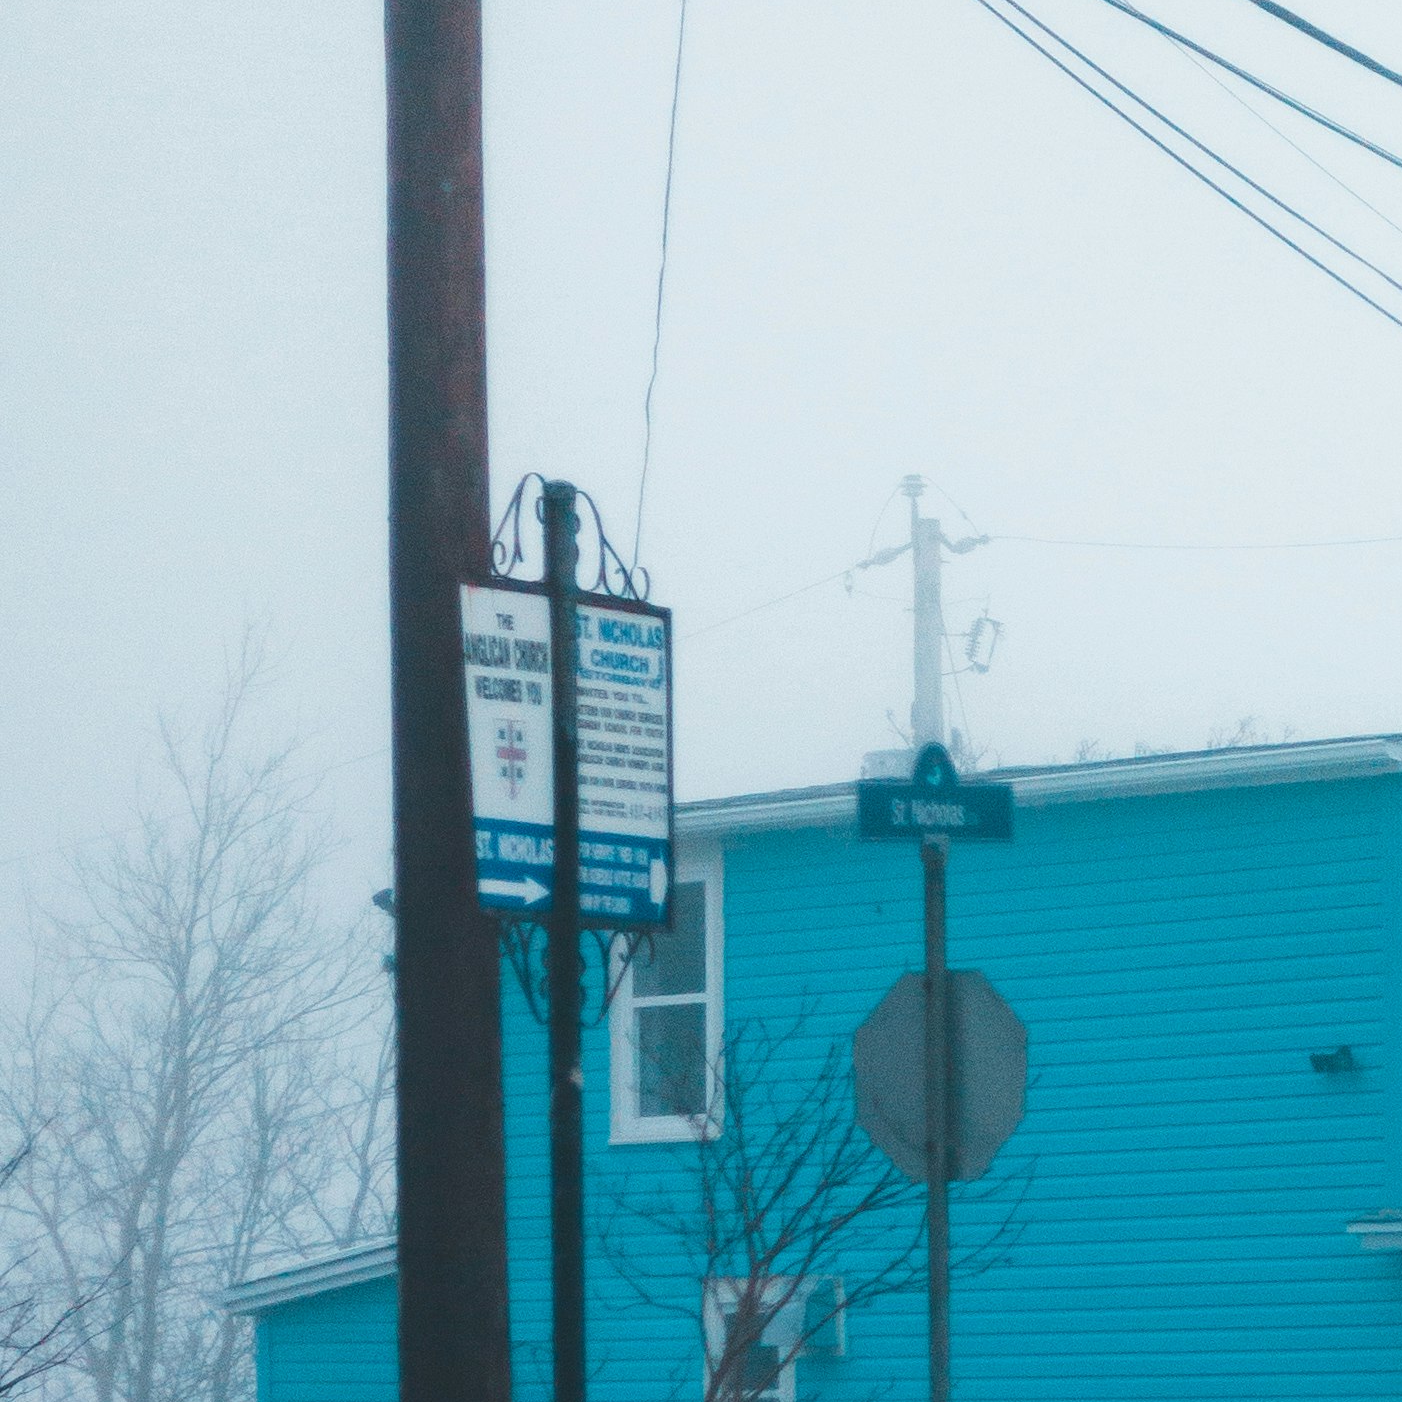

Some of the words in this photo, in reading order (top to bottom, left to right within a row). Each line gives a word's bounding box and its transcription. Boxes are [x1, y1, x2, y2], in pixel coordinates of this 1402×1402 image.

[495, 612, 514, 631] THE
[598, 618, 664, 651] NICHOLAS
[464, 632, 511, 670] ANGLICAN
[514, 638, 549, 674] CHURCH
[590, 649, 649, 674] CHURCH
[474, 675, 522, 703] WELCOMES
[524, 680, 542, 705] YOU
[498, 832, 554, 866] NICHOLAS
